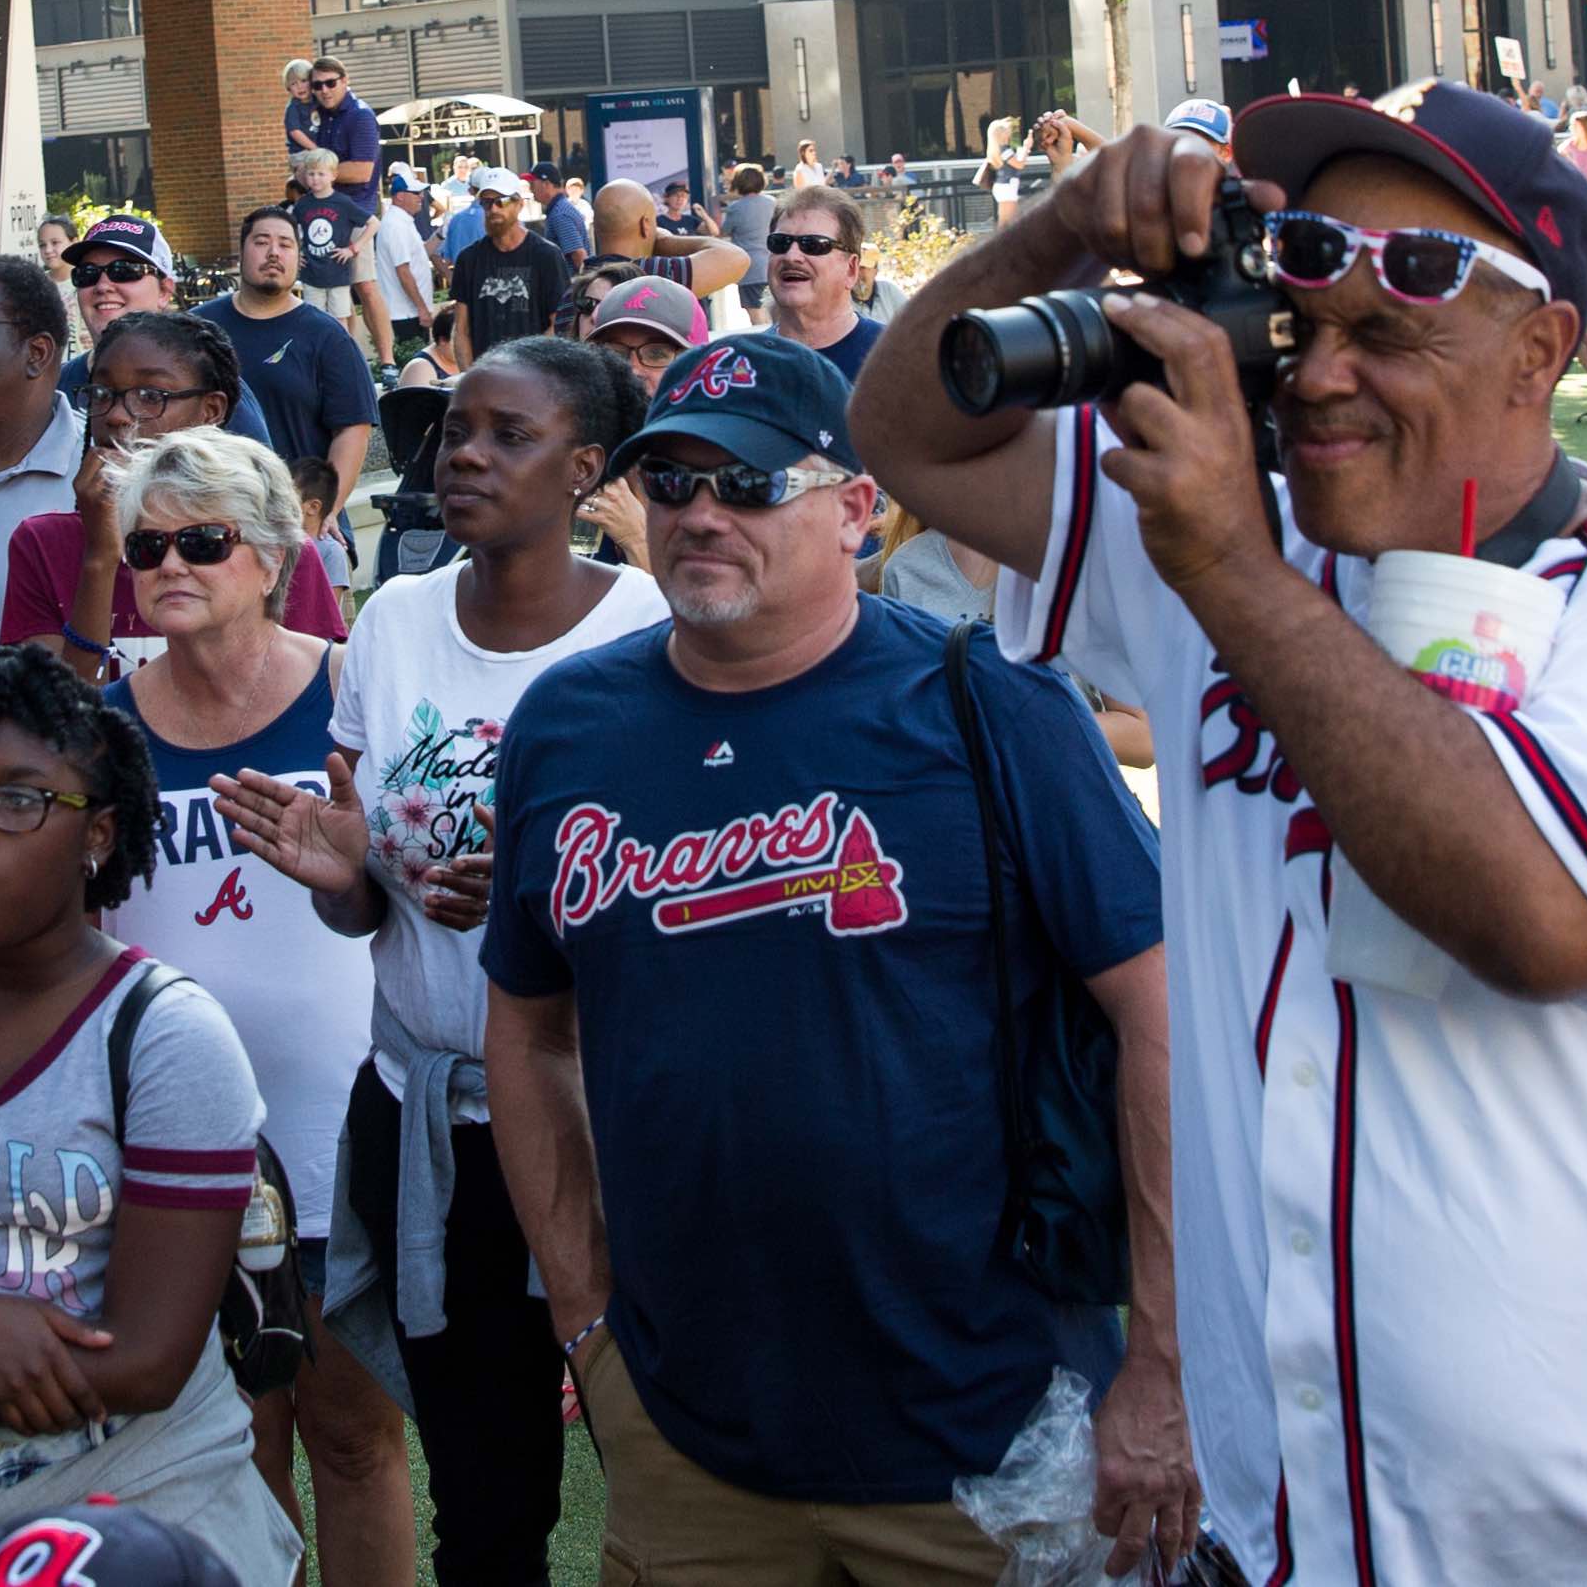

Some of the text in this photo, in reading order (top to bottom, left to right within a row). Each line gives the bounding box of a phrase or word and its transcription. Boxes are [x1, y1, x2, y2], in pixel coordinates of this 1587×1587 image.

[446, 783, 476, 809] in
[550, 791, 839, 940] Braves
[194, 866, 254, 927] A
